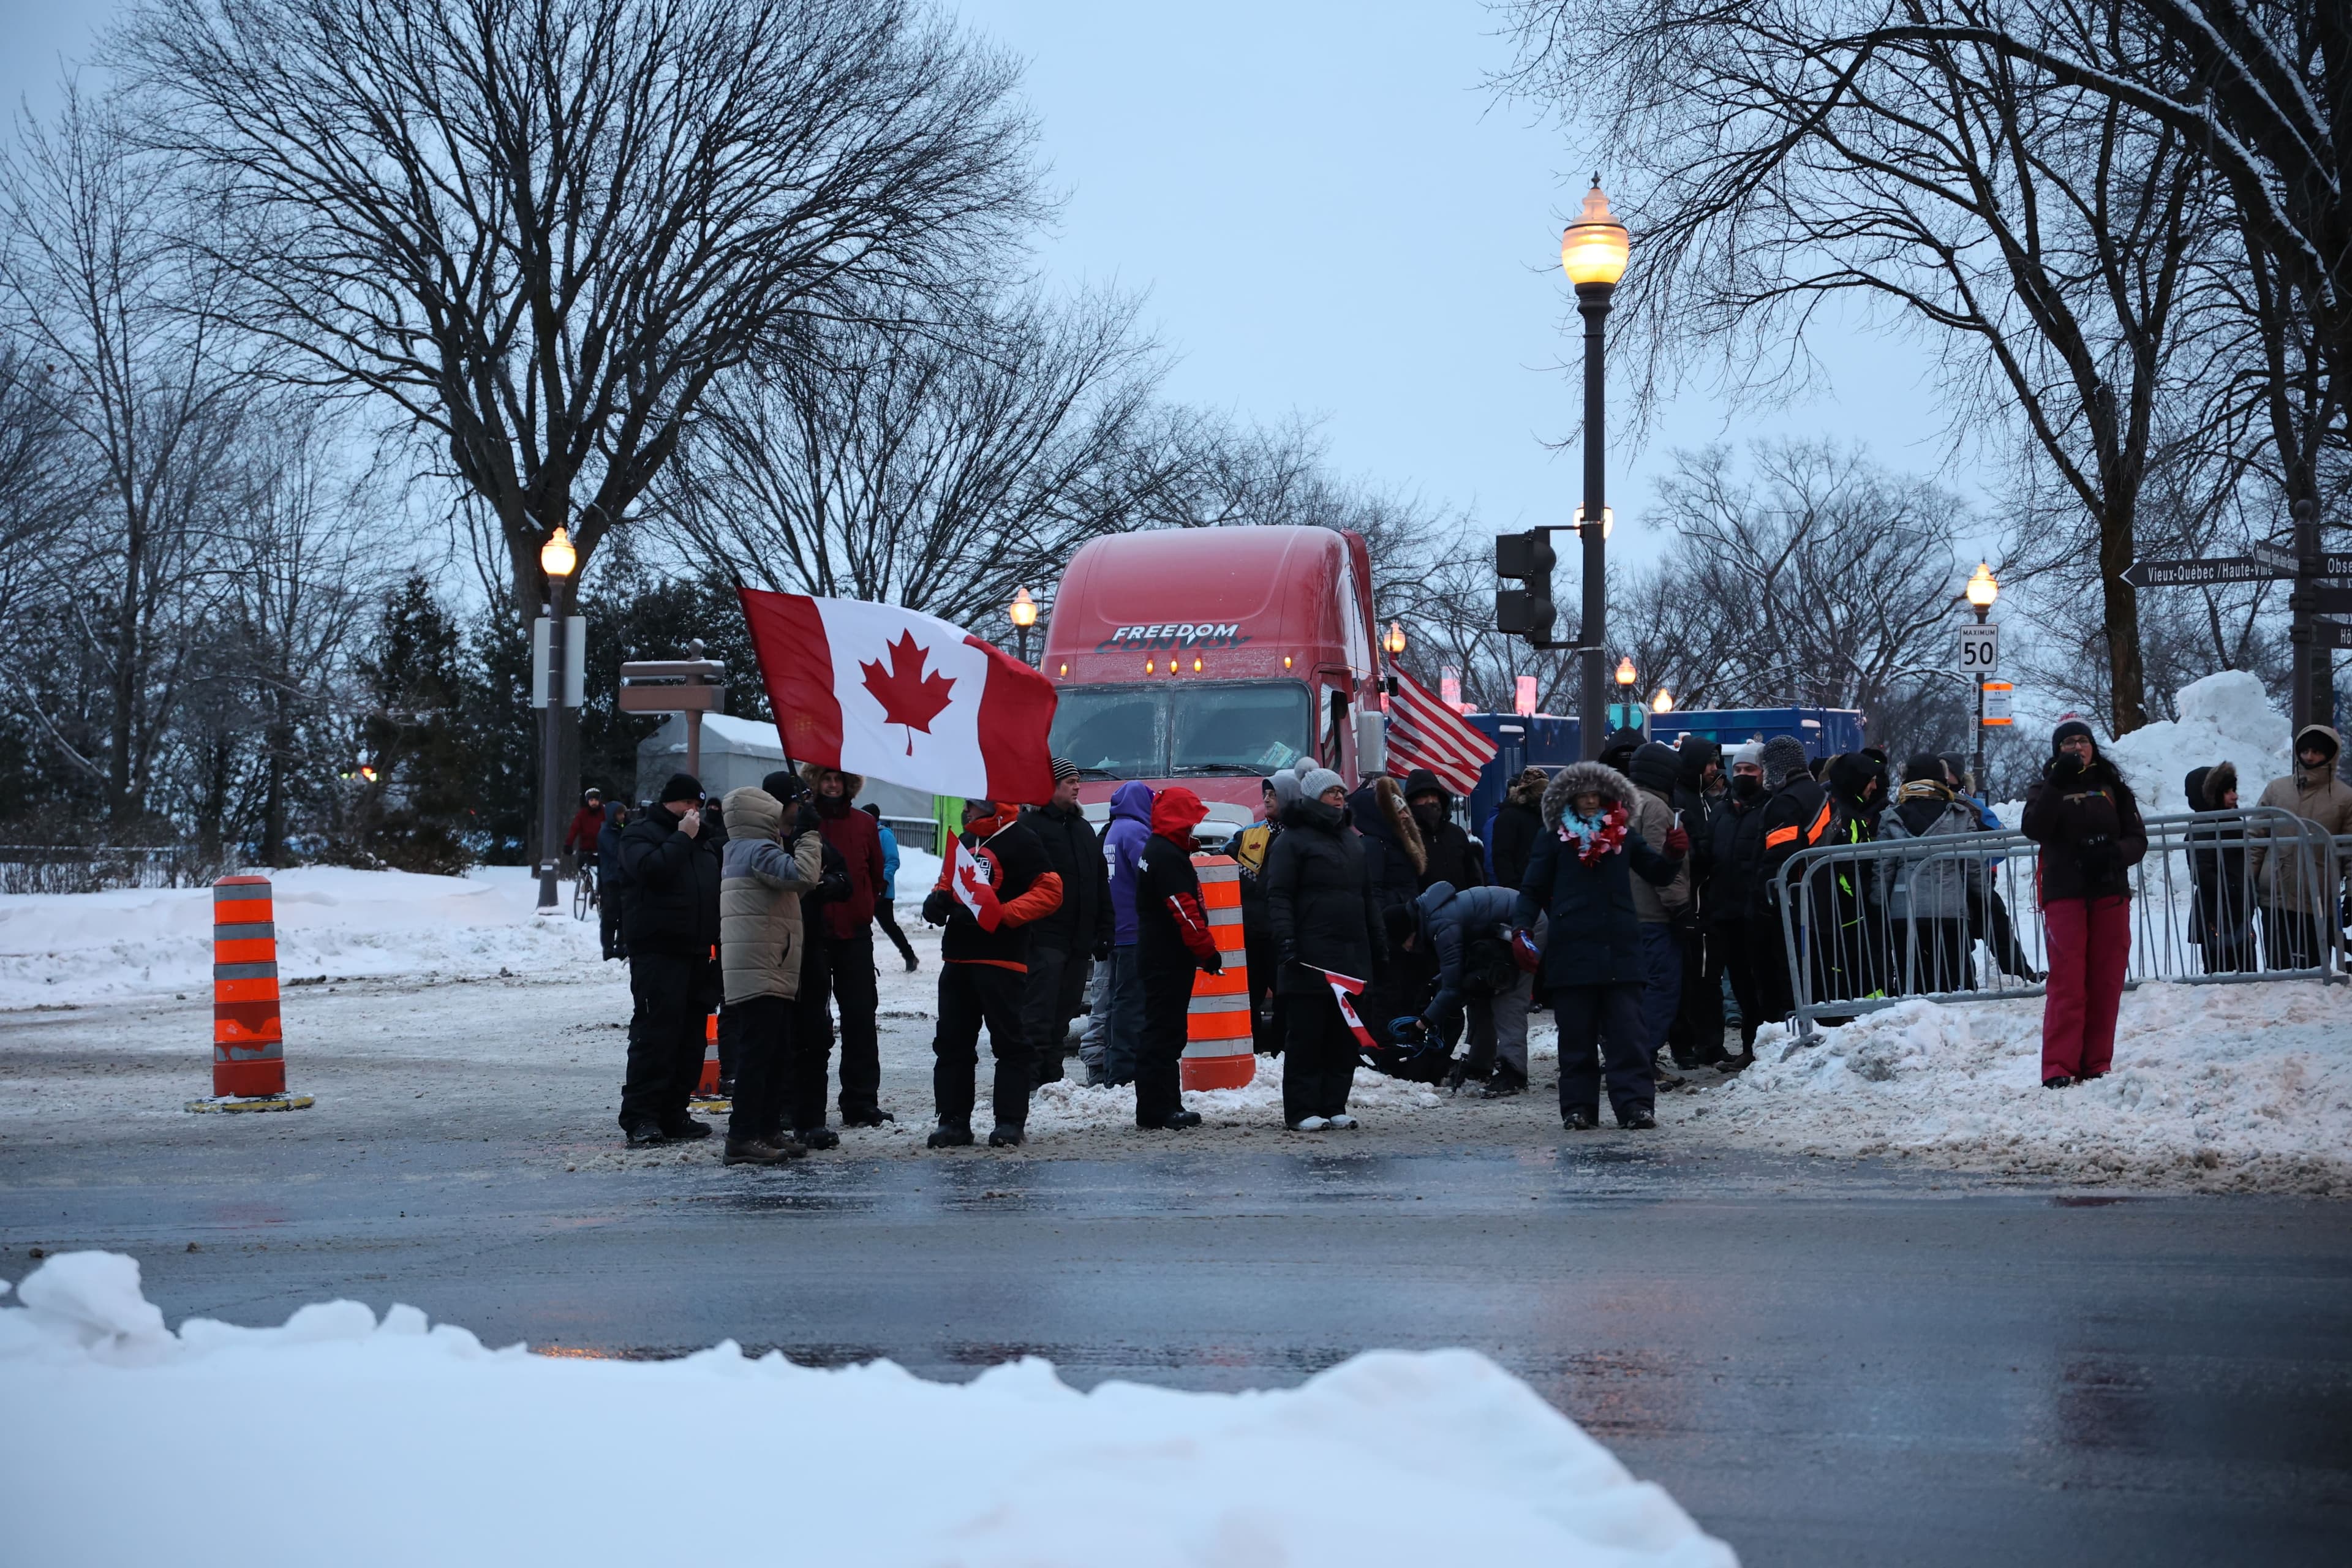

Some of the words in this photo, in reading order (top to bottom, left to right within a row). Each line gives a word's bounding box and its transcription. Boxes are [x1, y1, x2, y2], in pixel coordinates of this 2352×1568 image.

[2148, 564, 2214, 582] Vieux-Québec
[1112, 623, 1240, 642] FREEDOM
[1094, 635, 1253, 655] CONVOY
[1964, 641, 1994, 665] 50
